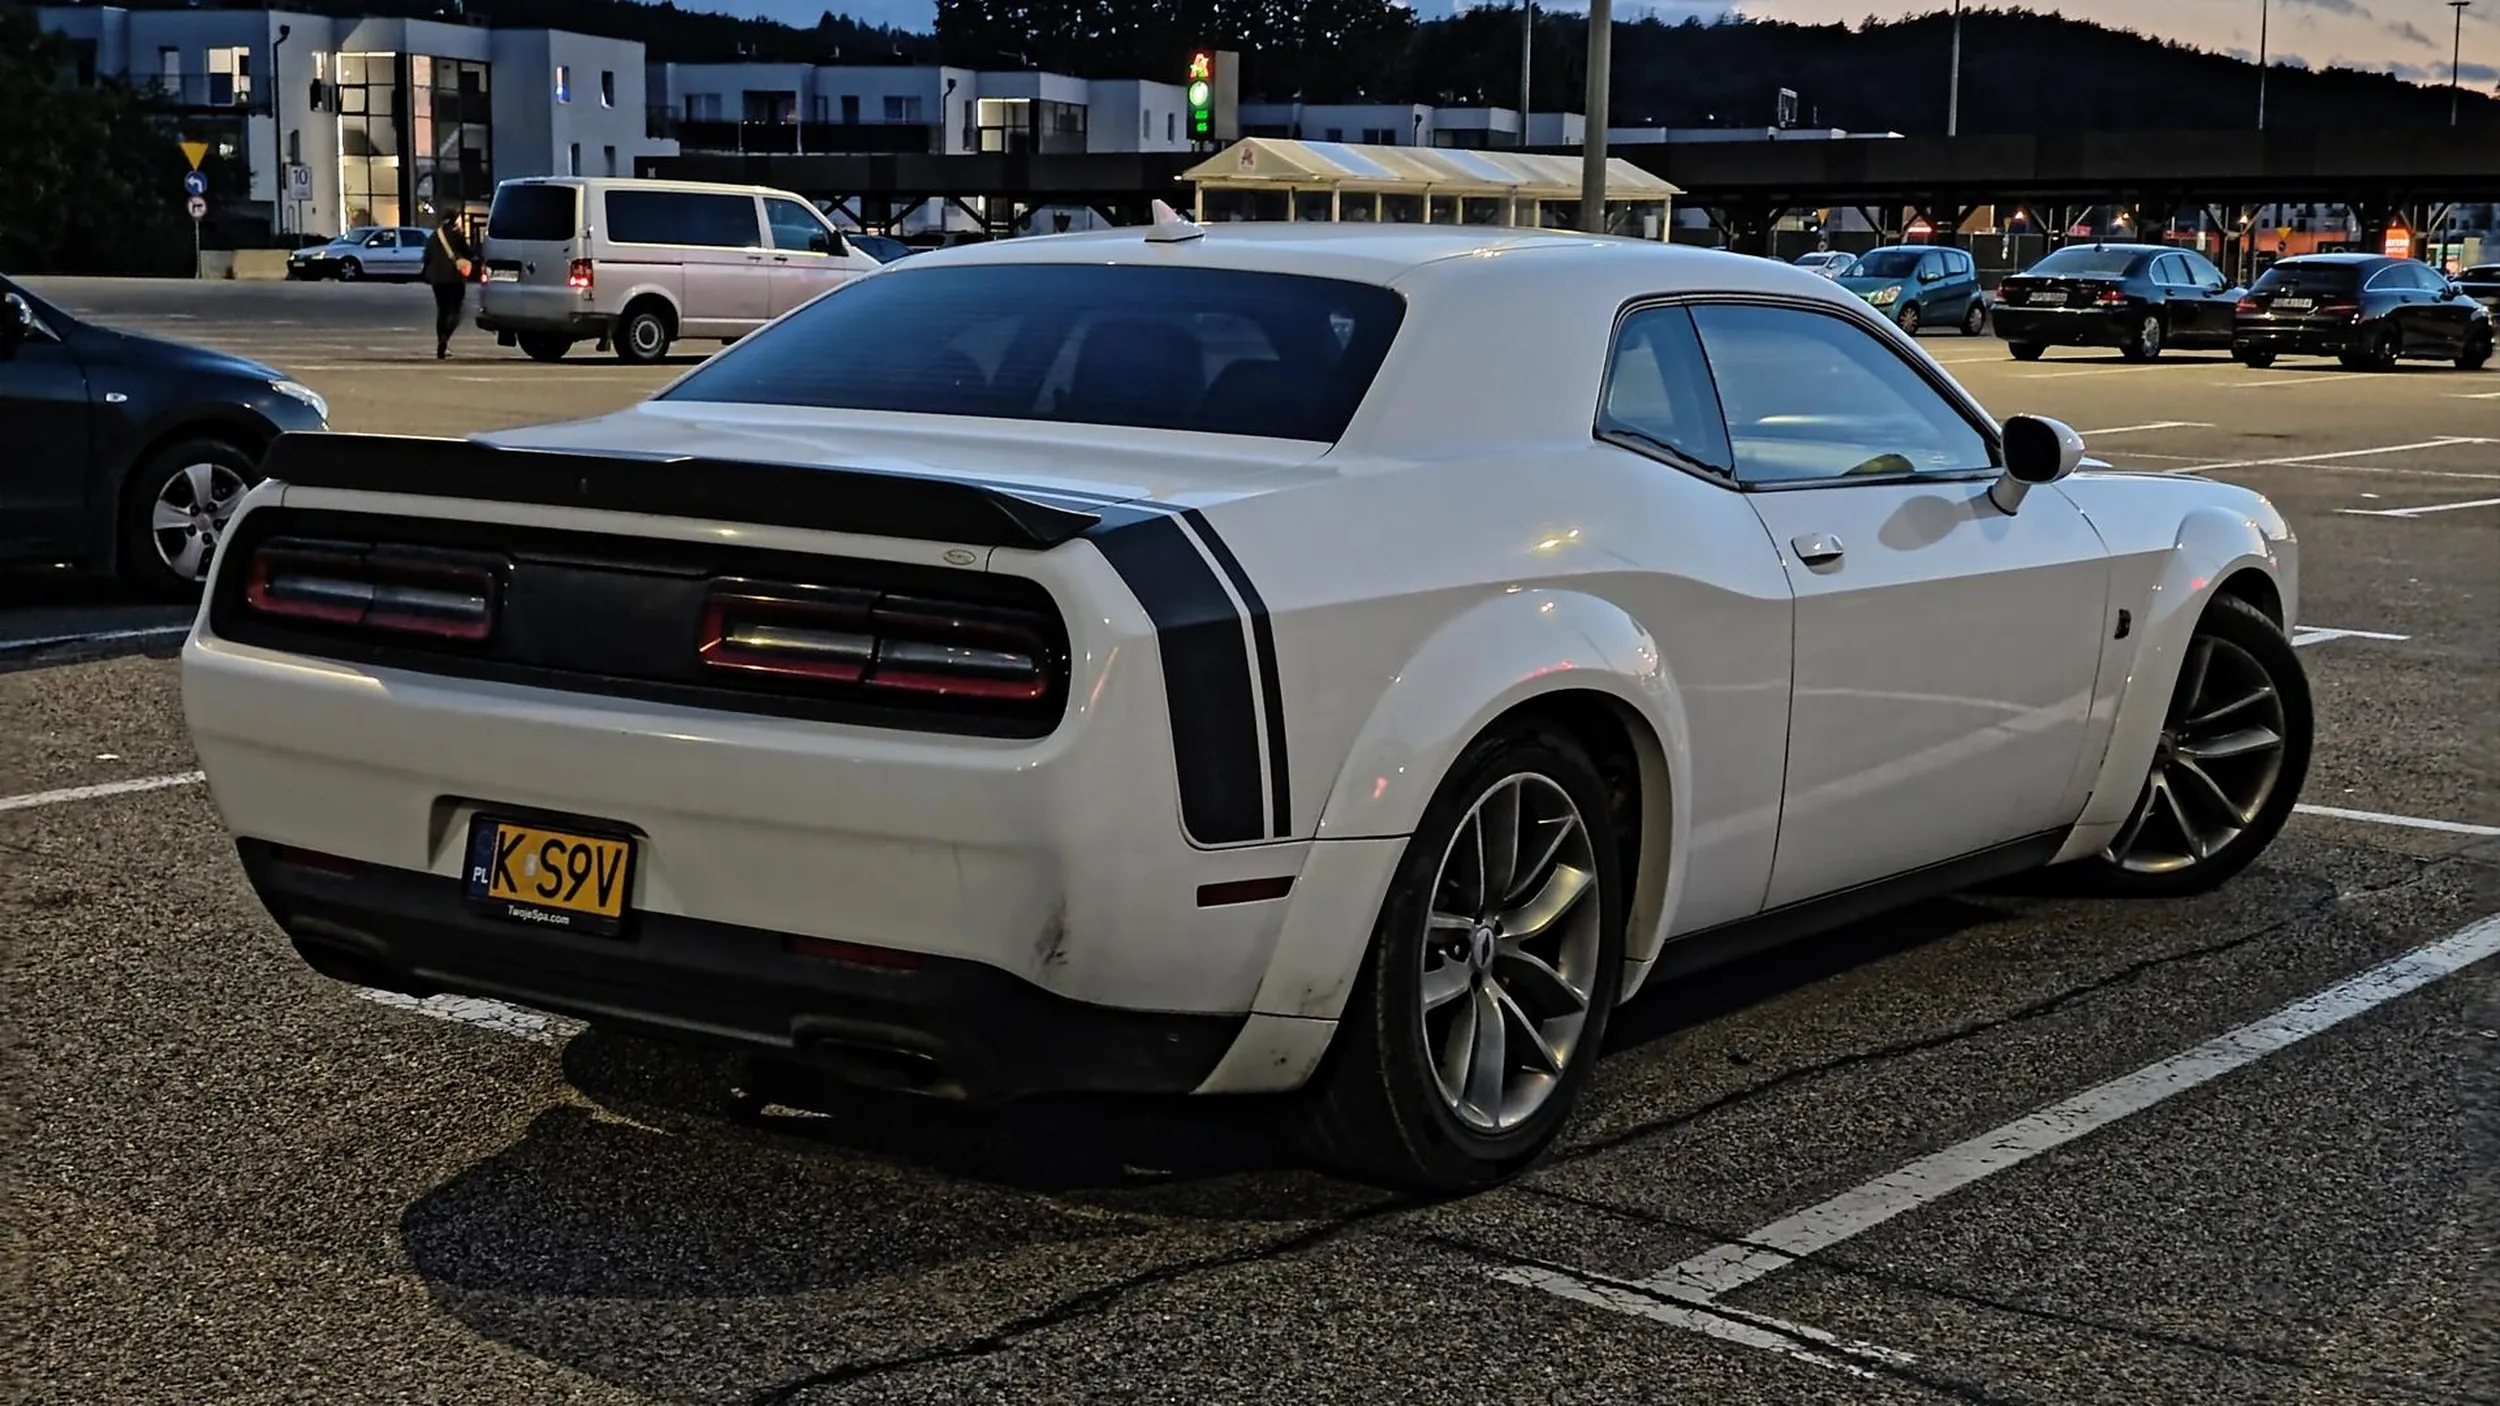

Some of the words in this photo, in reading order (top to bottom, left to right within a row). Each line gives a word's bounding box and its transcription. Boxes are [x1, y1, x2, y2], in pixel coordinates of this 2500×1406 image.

[293, 169, 308, 185] 10
[472, 866, 488, 884] PL
[492, 831, 526, 893] K
[536, 838, 622, 908] S9V
[508, 904, 570, 925] TwojeSpa.com
